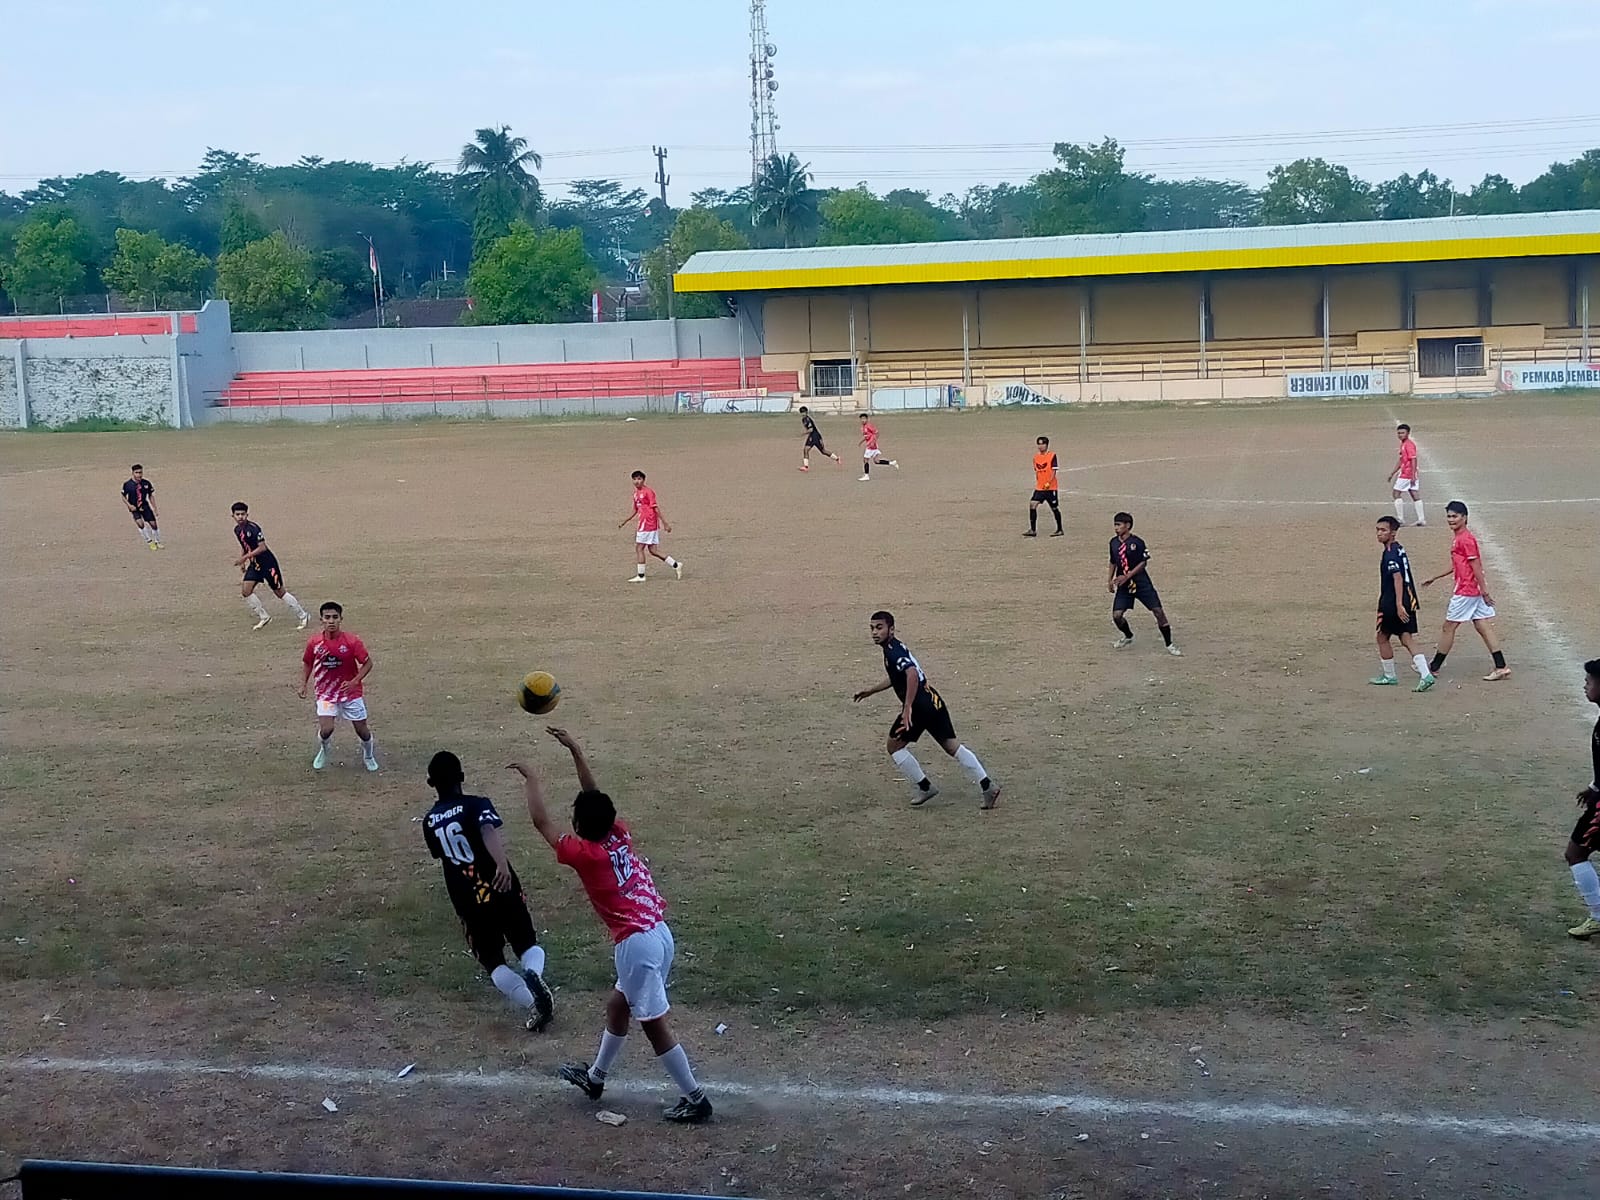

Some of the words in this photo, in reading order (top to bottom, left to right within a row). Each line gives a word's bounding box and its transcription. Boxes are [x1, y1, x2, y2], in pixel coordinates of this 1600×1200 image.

[1290, 376, 1337, 393] JEMBER
[1340, 374, 1369, 391] KONI
[1522, 370, 1565, 383] PEMKAB
[1566, 369, 1600, 382] JEMBE
[427, 805, 463, 828] JEMBER
[434, 821, 475, 866] 16
